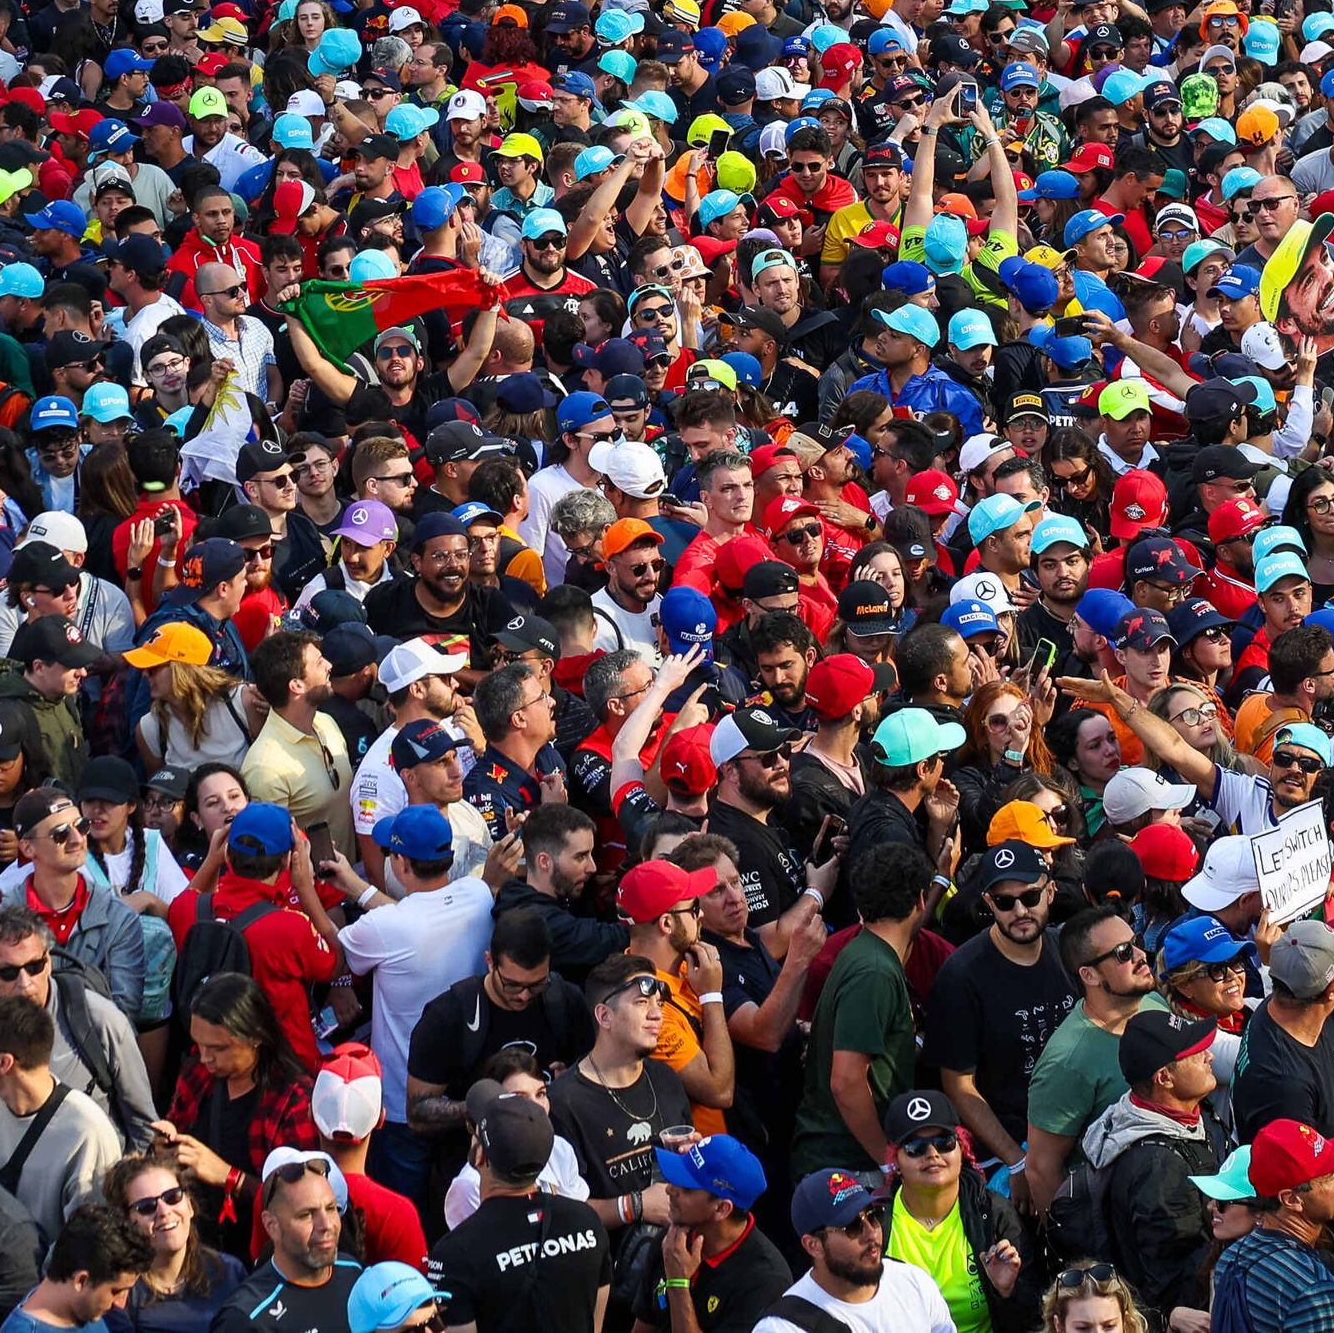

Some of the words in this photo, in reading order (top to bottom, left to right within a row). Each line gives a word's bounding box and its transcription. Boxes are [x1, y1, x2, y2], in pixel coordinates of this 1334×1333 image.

[1015, 396, 1041, 405] PIRELLI
[1050, 527, 1075, 535] Porto
[1134, 566, 1154, 574] CarNext
[857, 603, 887, 614] McLaren
[1285, 822, 1326, 856] SWITCH
[609, 1151, 654, 1178] CALIF
